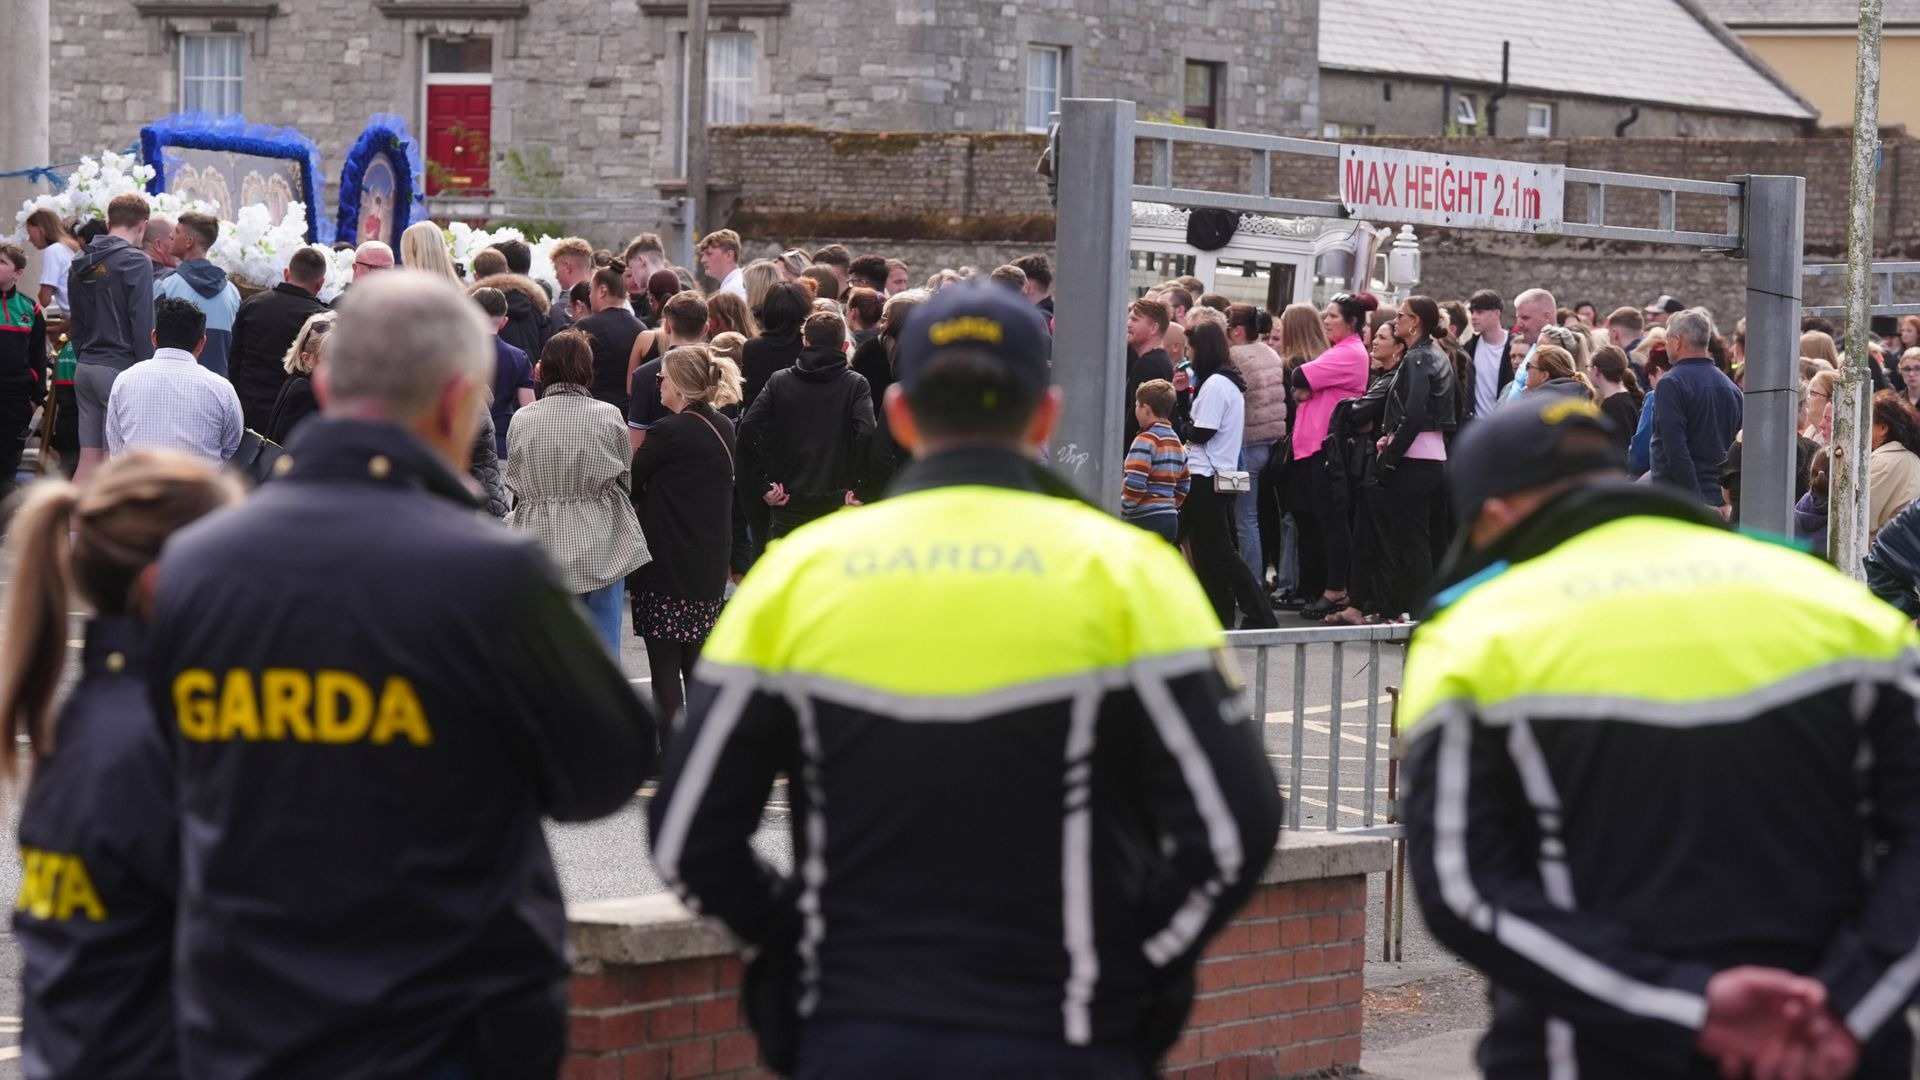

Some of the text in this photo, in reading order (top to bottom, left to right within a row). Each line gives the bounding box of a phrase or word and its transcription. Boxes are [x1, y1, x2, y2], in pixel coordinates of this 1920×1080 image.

[1346, 159, 1540, 219] MAX HEIGHT 2.1m
[843, 541, 1046, 579] GARDA
[172, 667, 433, 746] GARDA
